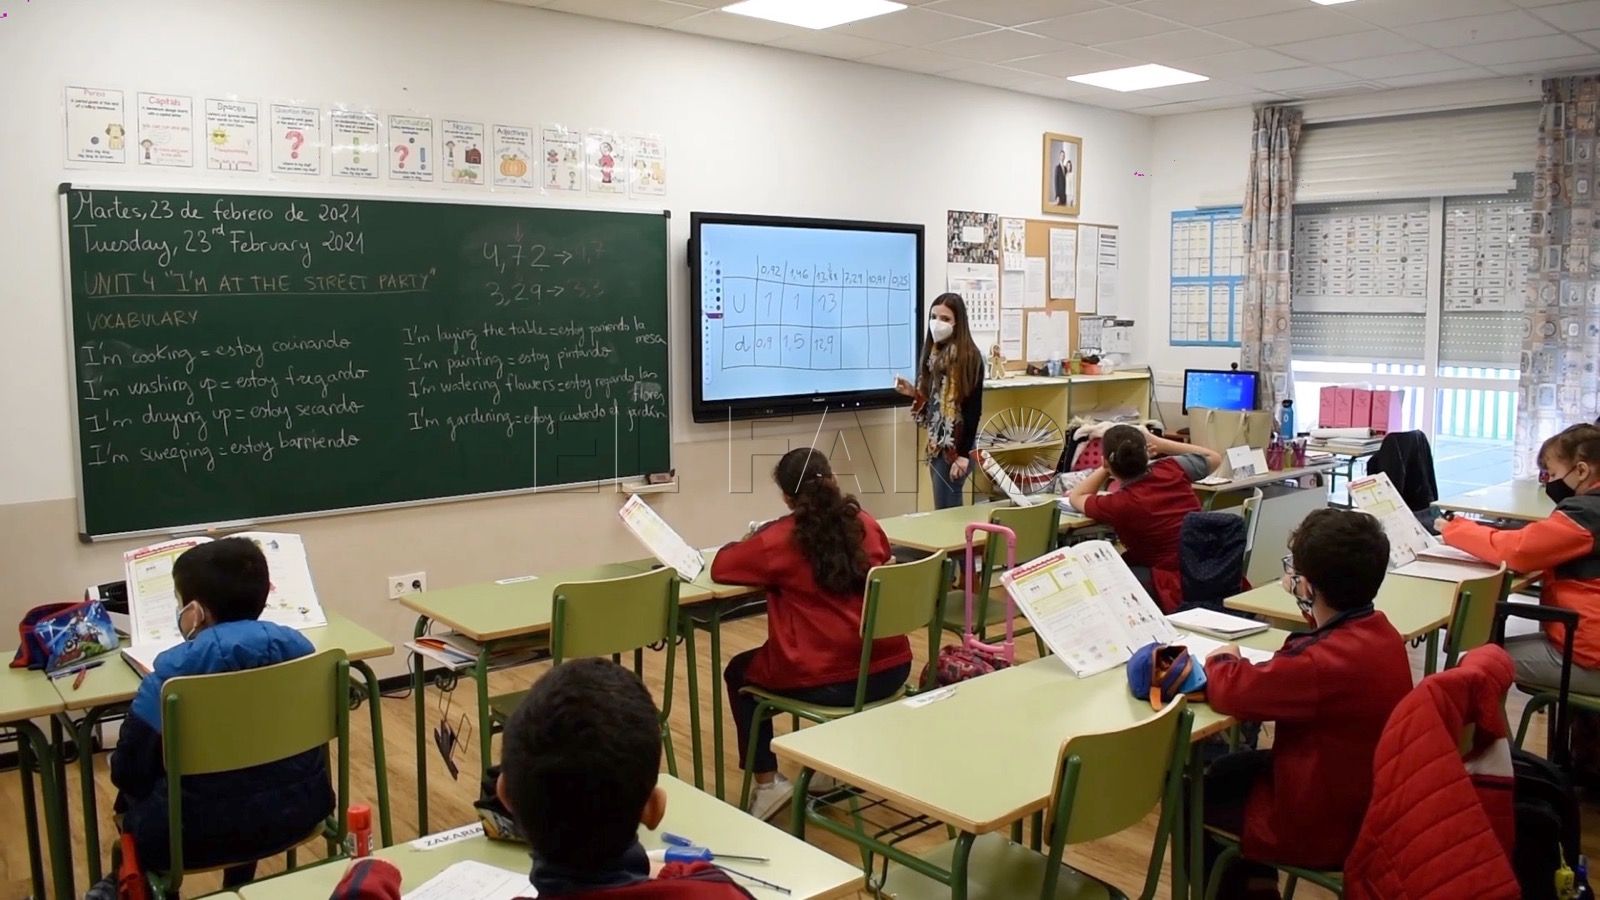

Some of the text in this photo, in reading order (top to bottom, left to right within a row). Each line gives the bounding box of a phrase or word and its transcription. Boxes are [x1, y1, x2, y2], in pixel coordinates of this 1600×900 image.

[149, 200, 174, 219] 23
[180, 201, 204, 220] de
[212, 199, 274, 221] febrero
[284, 202, 309, 222] de
[318, 203, 361, 224] 2021
[72, 224, 178, 267] Tuesday,
[229, 230, 312, 269] February
[322, 230, 364, 255] 2021
[84, 270, 137, 296] UNIT
[142, 269, 156, 292] 4
[219, 275, 244, 292] AT
[249, 274, 291, 292] THE
[303, 273, 368, 291] STREET
[760, 265, 781, 277] 0,92
[86, 309, 199, 332] VOCABULARY
[817, 292, 838, 314] 13
[402, 323, 431, 346] I'm
[437, 324, 480, 356] laying
[483, 321, 506, 337] the
[509, 319, 547, 336] table
[558, 320, 586, 348] estoy
[633, 315, 647, 331] la
[635, 333, 667, 345] mesa
[783, 332, 805, 352] 1,5
[81, 341, 123, 366] I'm
[132, 343, 197, 375] cooking
[215, 336, 264, 369] estoy
[403, 352, 439, 372] I'm
[447, 349, 504, 380] painting
[517, 347, 551, 372] estoy
[557, 340, 613, 369] pintando
[81, 375, 121, 400] I'm
[127, 374, 194, 406] washing
[199, 376, 217, 404] up
[236, 369, 279, 399] estoy
[403, 376, 436, 399] I'm
[440, 371, 502, 406] watering
[504, 372, 556, 393] flowers
[564, 373, 593, 400] estoy
[638, 365, 658, 380] las
[84, 407, 133, 433] I'm
[141, 402, 209, 442] drying
[212, 406, 232, 437] up
[250, 399, 293, 430] estoy
[295, 392, 366, 418] secando
[407, 406, 441, 431] I'm
[445, 406, 515, 442] gardening
[87, 442, 130, 466] I'm
[139, 442, 217, 473] sweeping
[229, 434, 275, 462] estoy
[278, 427, 361, 449] barriendo
